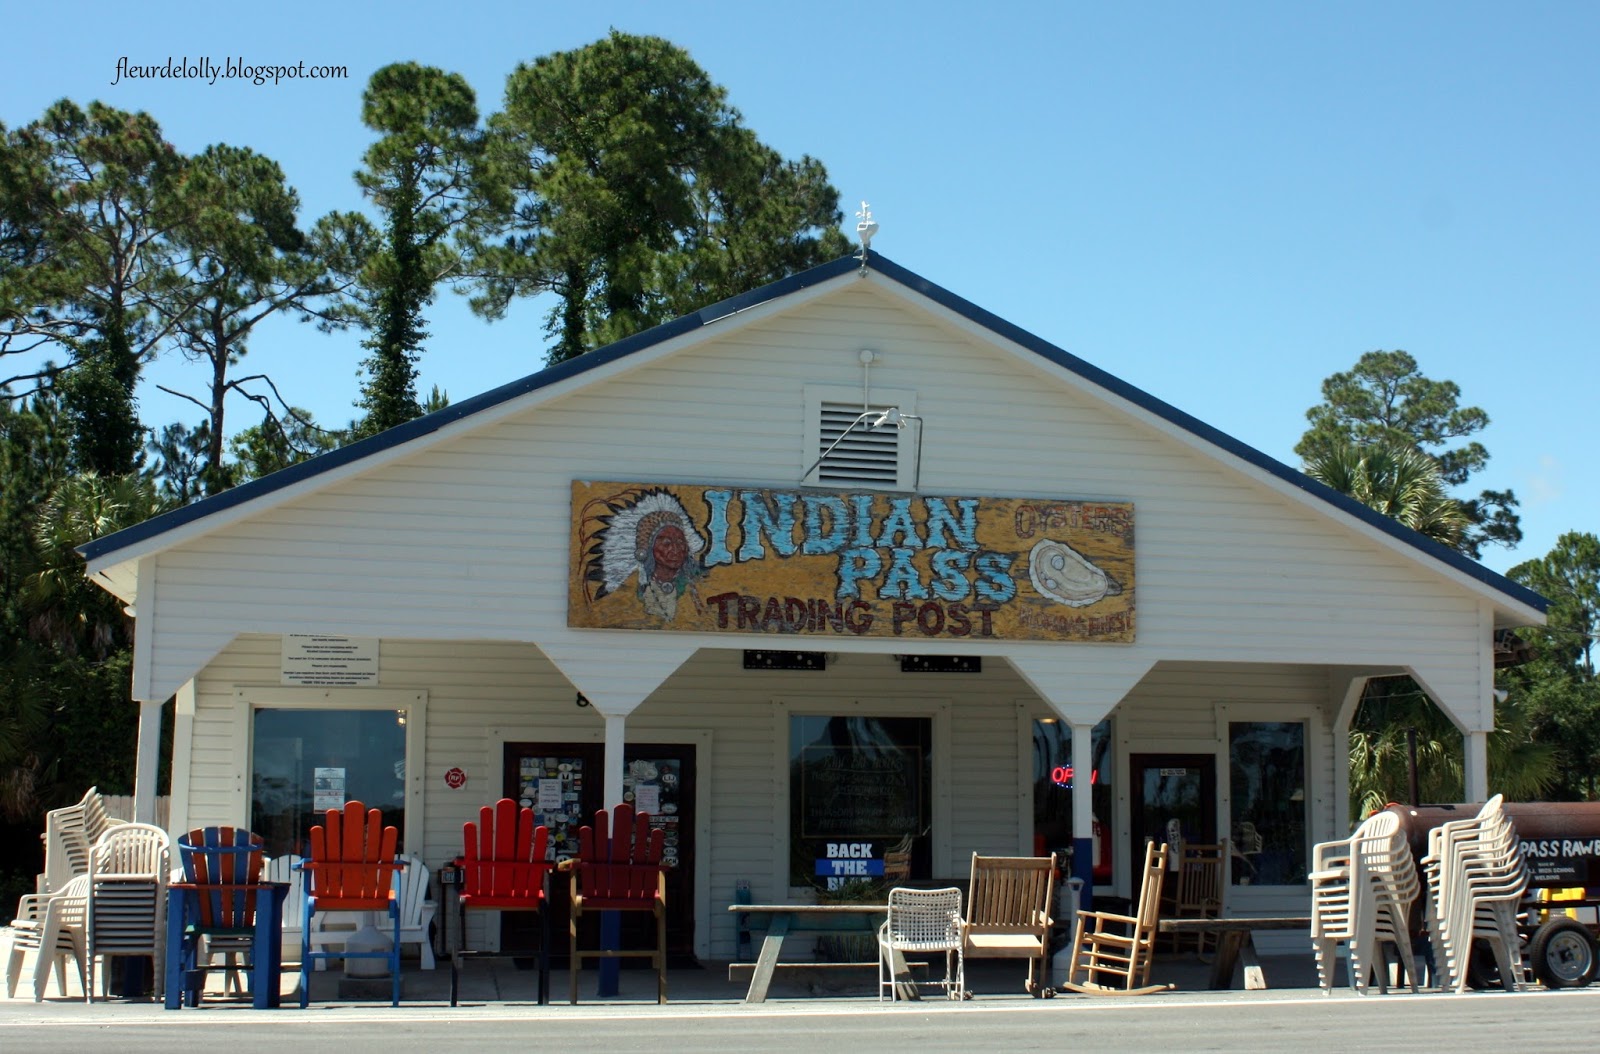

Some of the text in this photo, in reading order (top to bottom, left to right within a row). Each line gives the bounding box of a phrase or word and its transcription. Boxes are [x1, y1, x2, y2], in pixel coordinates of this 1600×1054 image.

[703, 489, 980, 567] INDIAN
[1015, 503, 1131, 539] OYSTERS
[836, 545, 1017, 602] PASS
[706, 592, 1000, 636] TRADING POST
[826, 843, 873, 858] BACK
[1520, 840, 1560, 857] PASS
[831, 860, 868, 876] THE
